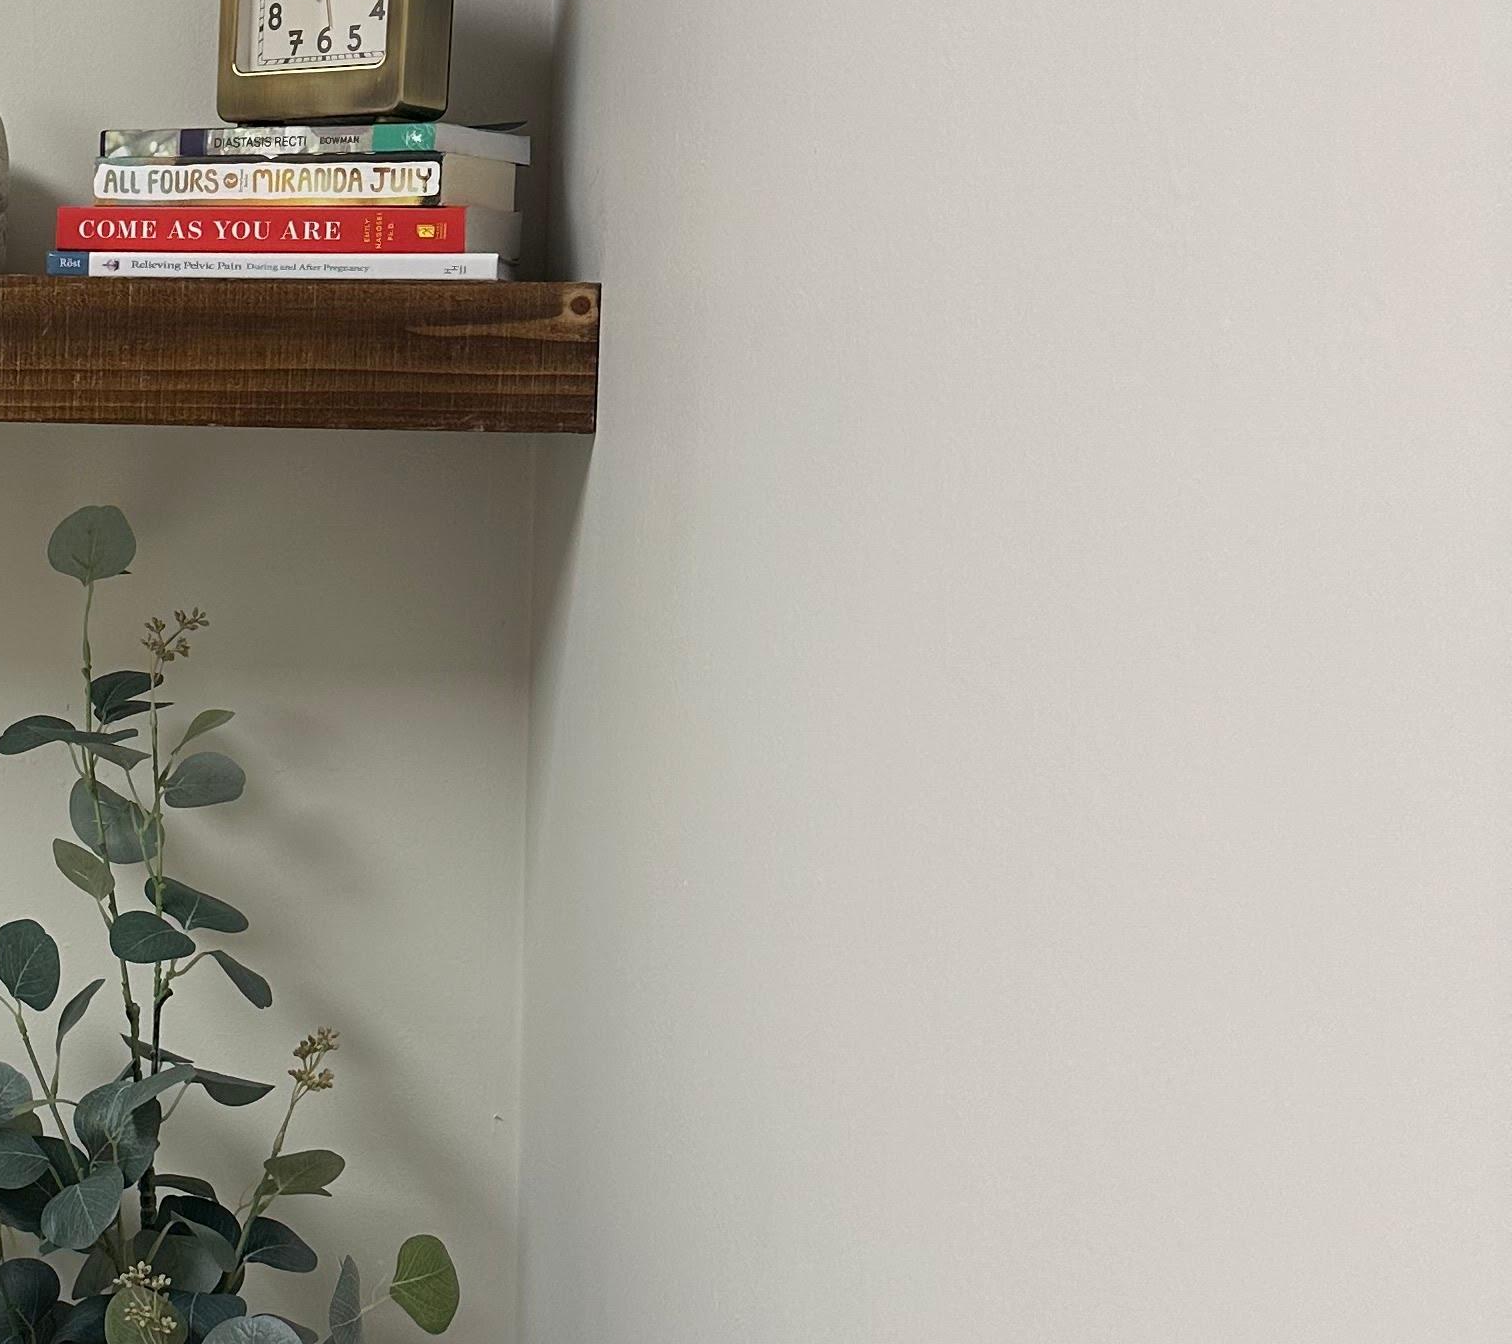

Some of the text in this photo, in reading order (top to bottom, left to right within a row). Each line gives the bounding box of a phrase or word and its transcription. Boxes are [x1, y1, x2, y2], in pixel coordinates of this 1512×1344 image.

[268, 3, 282, 30] 8
[289, 30, 303, 55] 7
[317, 26, 332, 53] 6
[347, 25, 361, 51] 5
[214, 136, 307, 148] DIASTASIS RECTI
[319, 136, 360, 144] BOWMAN
[103, 169, 140, 193] ALL
[148, 169, 219, 194] FOURS
[252, 167, 363, 193] MIRANDA
[370, 167, 432, 193] JULY
[78, 219, 341, 240] COME AS YOU ARE
[131, 260, 370, 273] Relieving Pelvic Pain During and After Pregnancy
